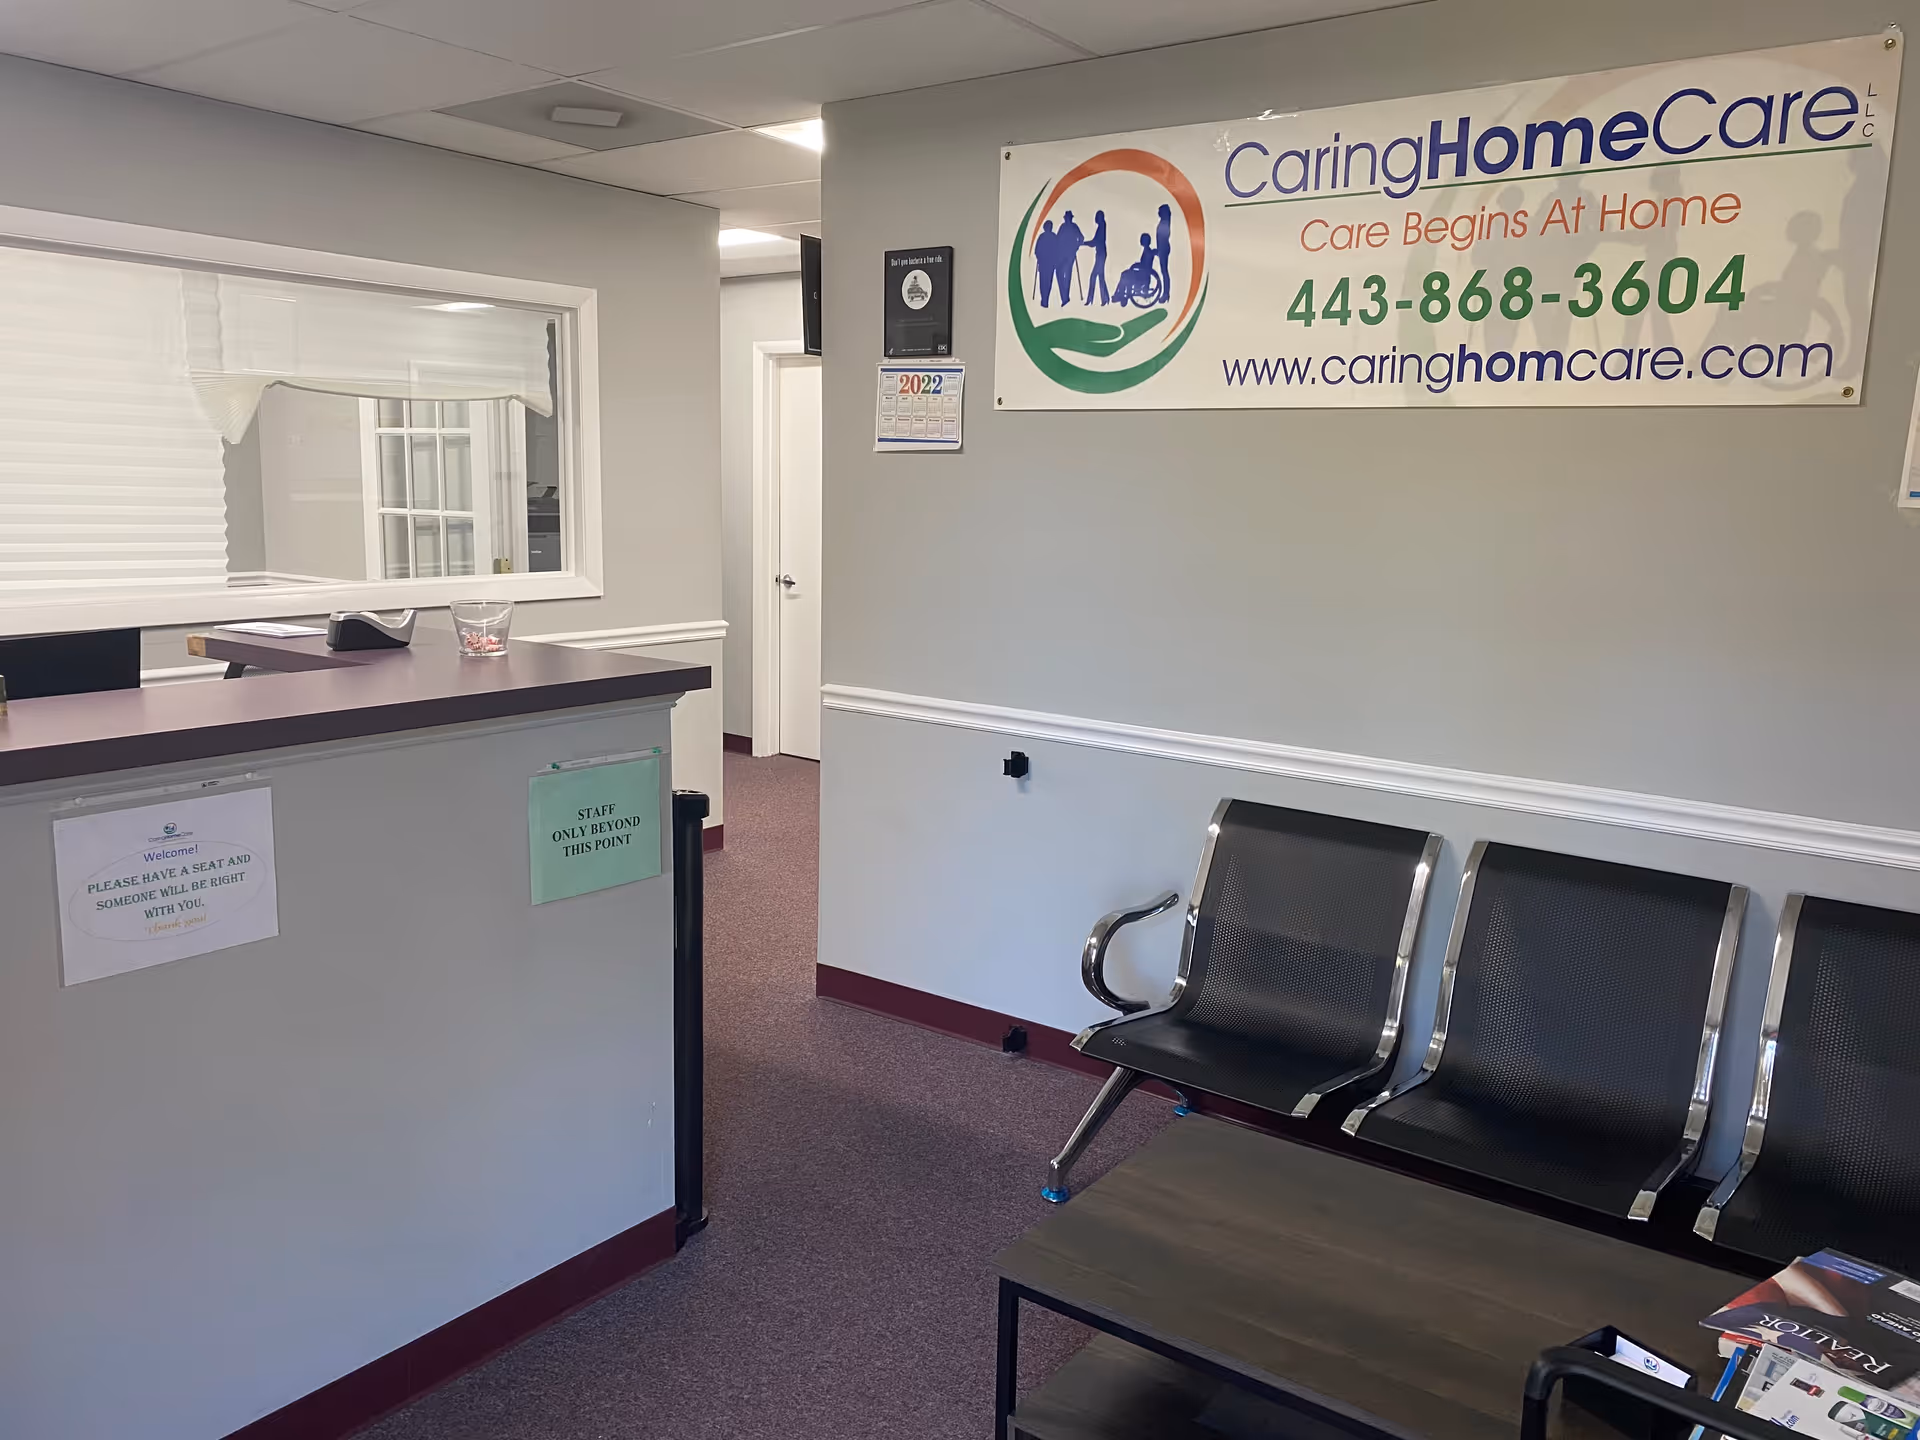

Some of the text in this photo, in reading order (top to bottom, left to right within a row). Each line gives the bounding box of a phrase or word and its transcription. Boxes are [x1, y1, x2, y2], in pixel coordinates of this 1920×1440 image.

[1225, 87, 1859, 199] CaringHomeCare
[1299, 192, 1743, 253] Care Begins At Home
[1286, 255, 1745, 328] 443-868-3604
[898, 374, 943, 395] 2022
[1222, 341, 1834, 394] www.caringhomcare.com
[552, 815, 641, 843] ONLY BEYOND
[577, 803, 616, 821] STAFF
[143, 844, 199, 863] Welcome!
[563, 833, 632, 857] THIS POINT
[87, 853, 251, 894] PLEASE HAVE A SEAT AND
[96, 871, 246, 911] SOMEONE WILL BE RIGHT
[144, 897, 205, 919] WITH YOU.
[1759, 1313, 1893, 1375] REALTOR
